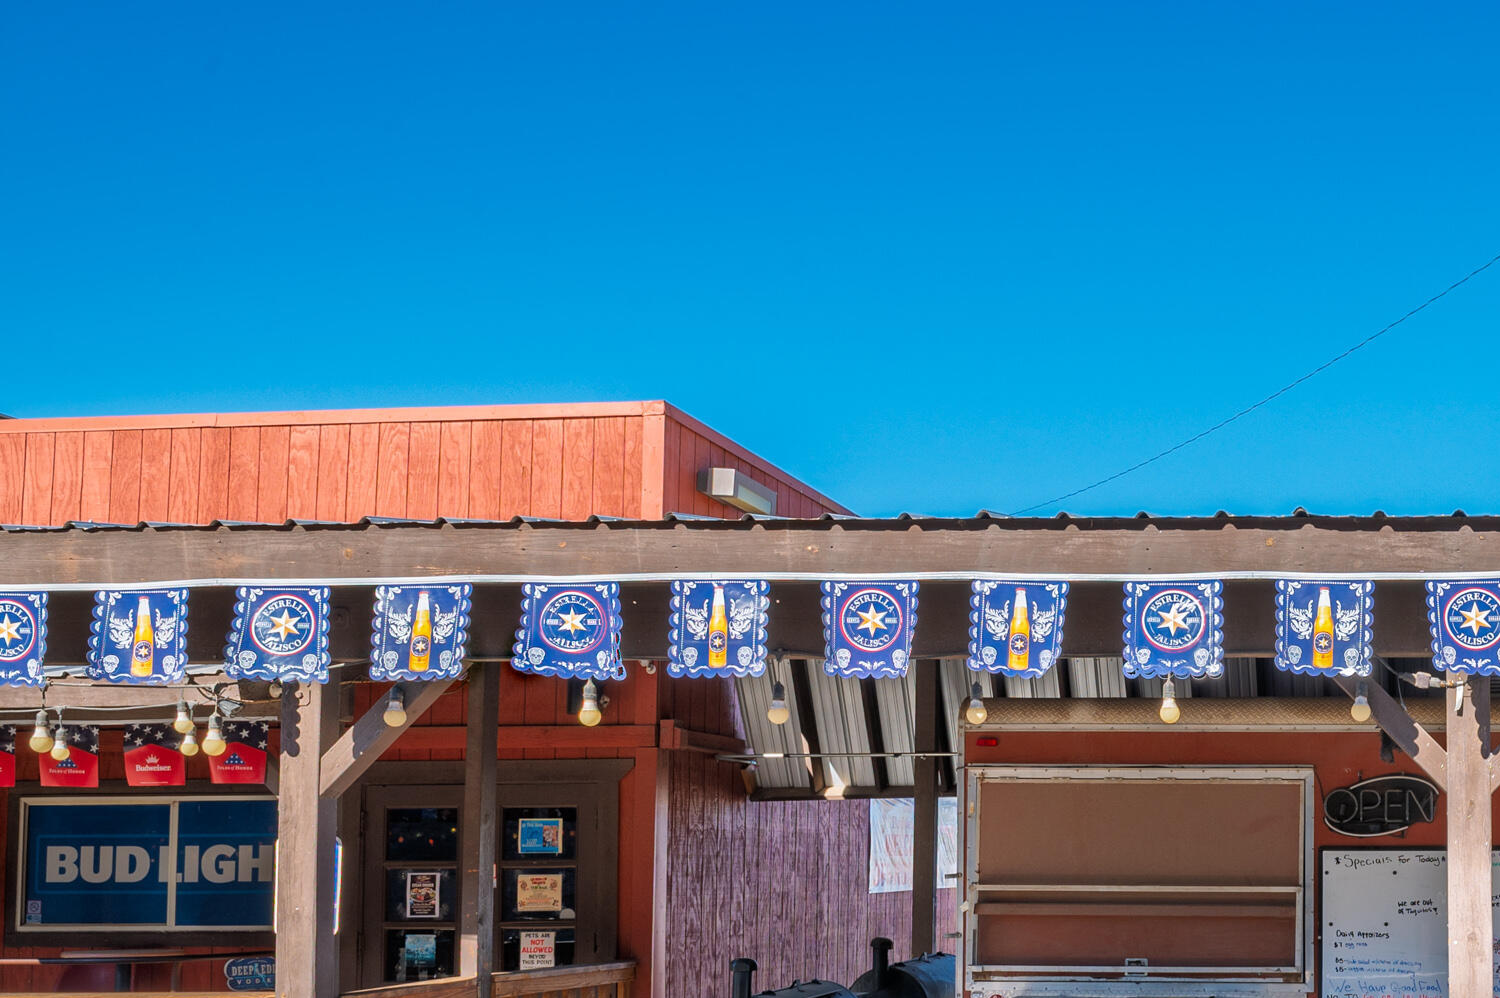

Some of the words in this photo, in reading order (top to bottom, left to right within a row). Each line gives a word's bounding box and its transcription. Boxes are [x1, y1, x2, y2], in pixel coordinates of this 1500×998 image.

[262, 599, 308, 618] ESTRELLA
[549, 595, 597, 614] ESTRELLA
[849, 592, 894, 611] ESTRELLA
[1451, 593, 1497, 611] ESTRELLA
[0, 604, 28, 623] RELLA
[854, 634, 890, 647] JALISCO
[1154, 633, 1192, 646] JALISCO
[1456, 632, 1494, 645] JALISCO
[0, 644, 25, 656] LISCO
[1324, 787, 1434, 824] OPEN
[46, 846, 152, 884] BUD
[158, 845, 274, 883] LIGH
[1415, 854, 1441, 867] Today
[232, 965, 254, 976] DEEP
[237, 977, 272, 985] VODK
[1329, 979, 1352, 993] We
[1418, 979, 1442, 993] Food
